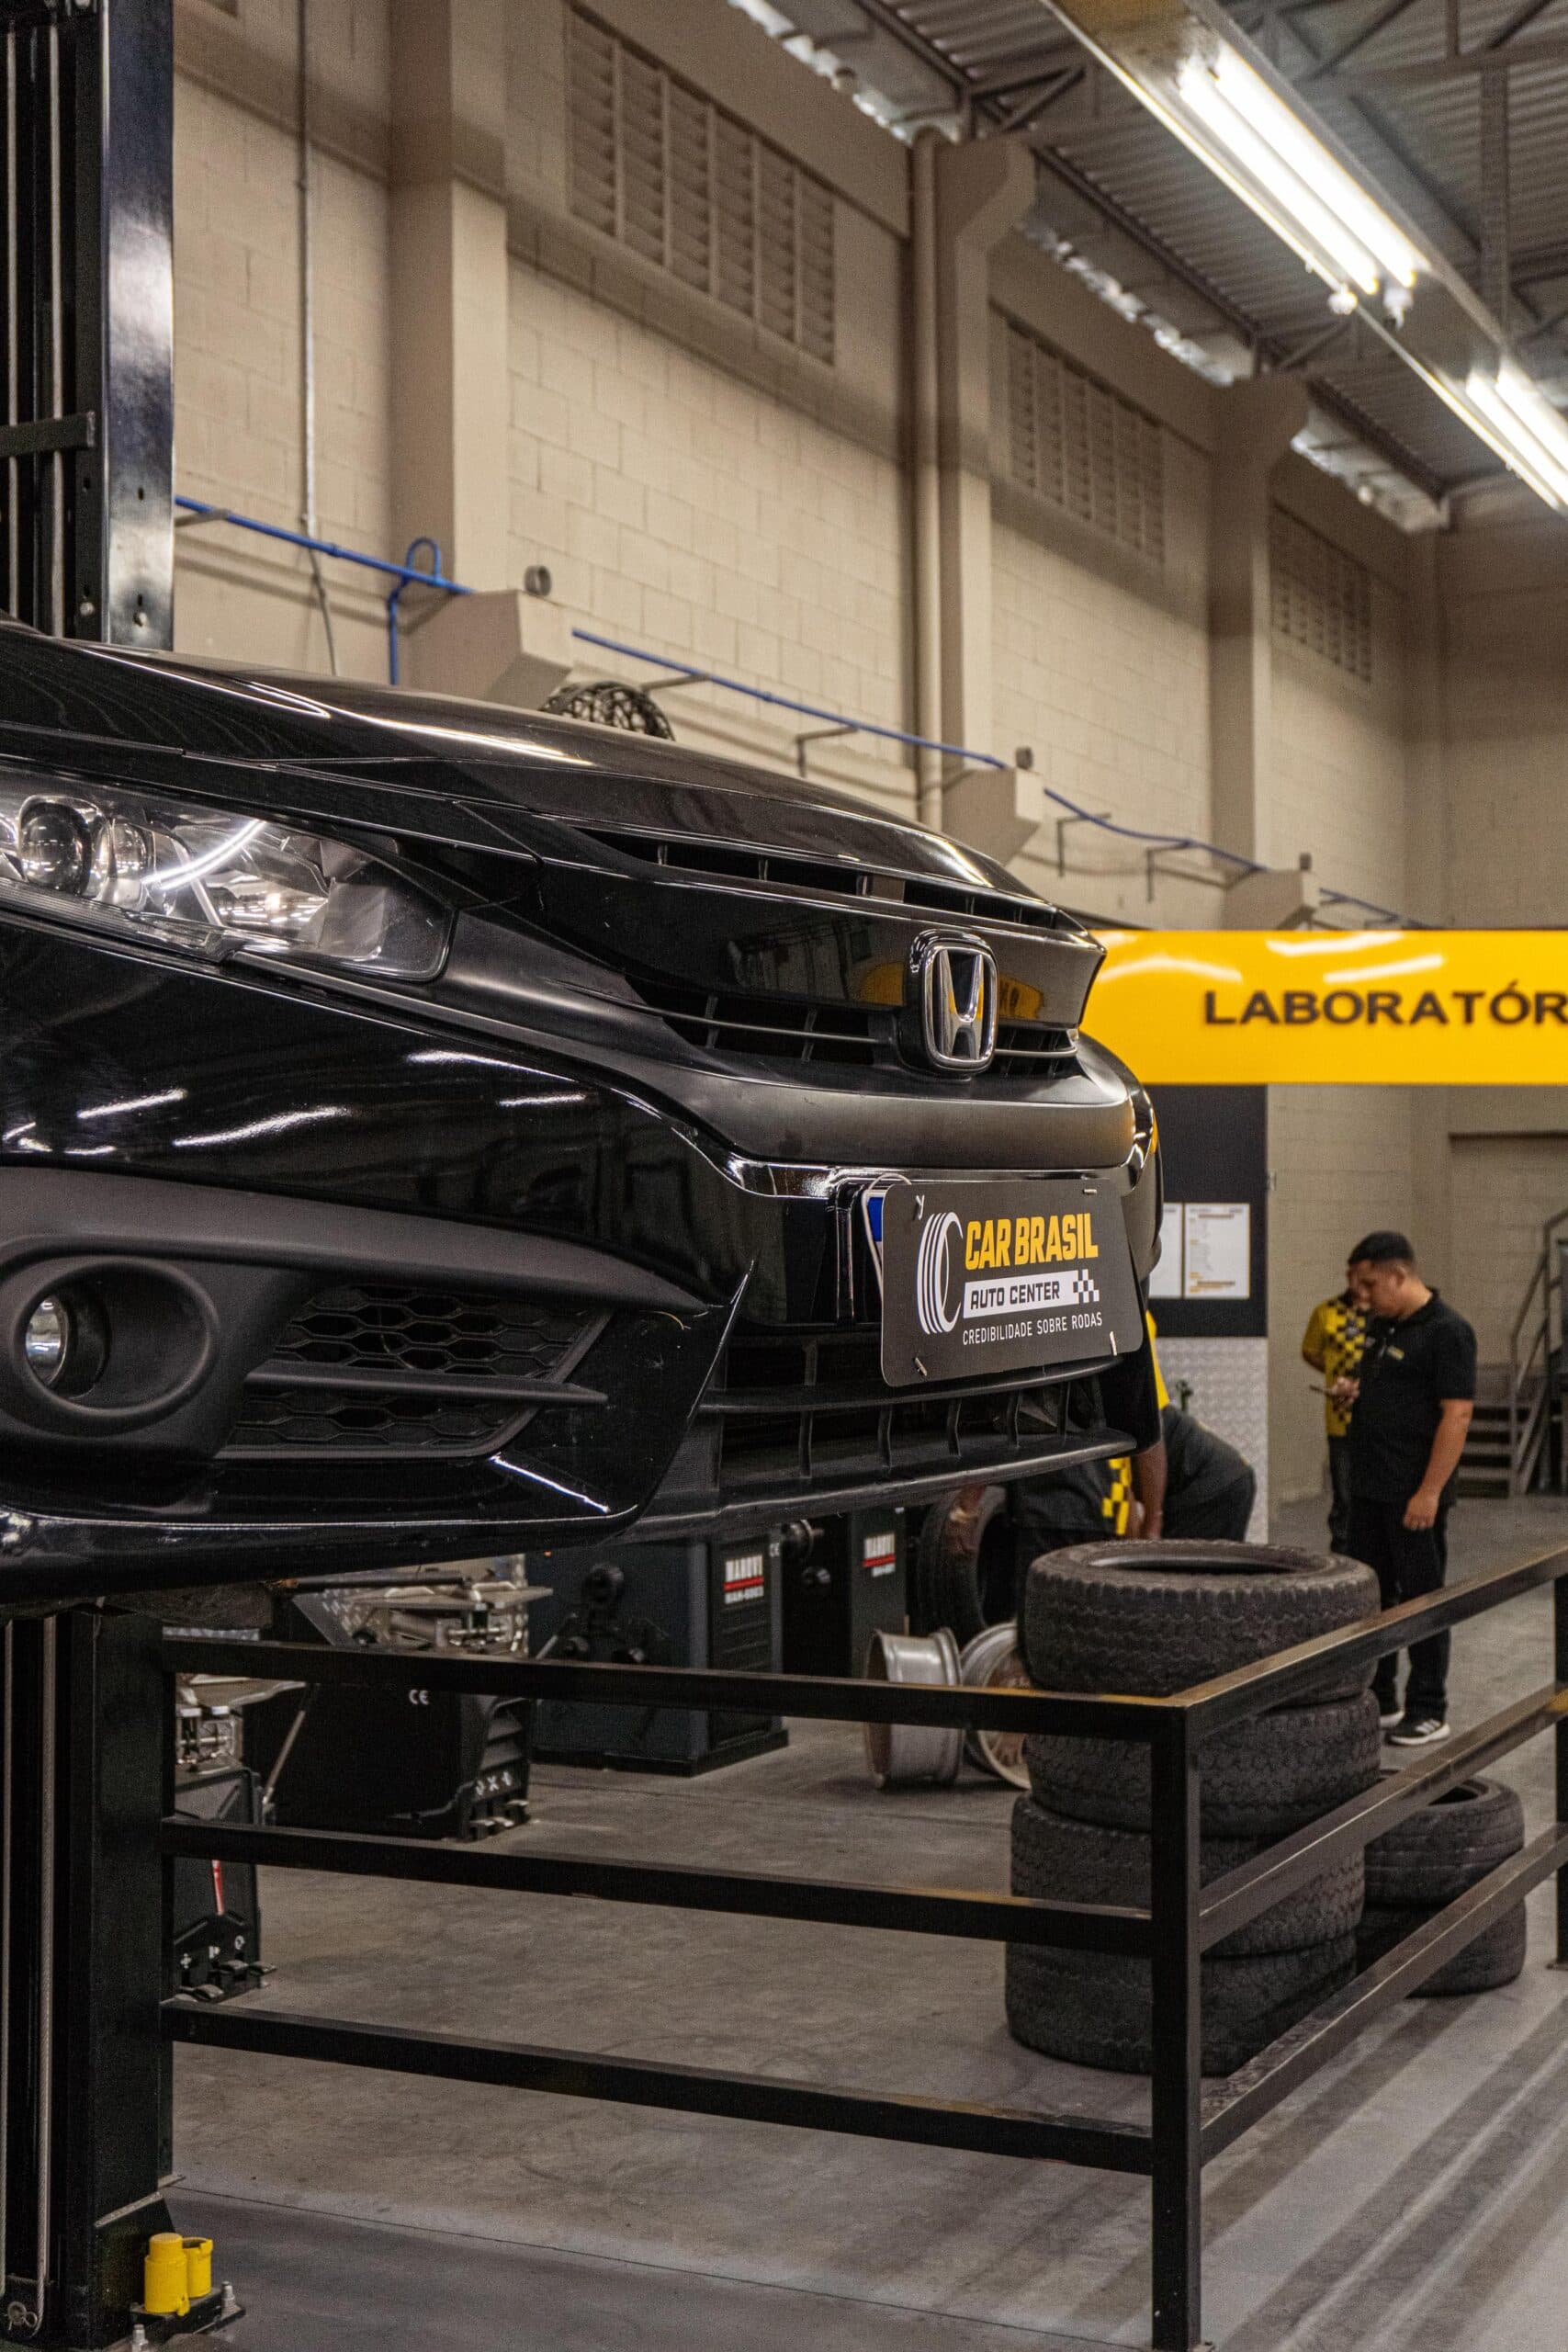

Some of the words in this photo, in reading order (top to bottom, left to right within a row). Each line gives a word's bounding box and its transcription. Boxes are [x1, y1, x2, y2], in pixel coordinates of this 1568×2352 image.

[965, 1219, 1011, 1270] CAR
[1014, 1213, 1099, 1266] BRASIL
[970, 1288, 1005, 1310] AUTO
[1010, 1281, 1060, 1305] CENTER
[963, 1321, 1032, 1346] CREDIBILIDADE
[1036, 1316, 1067, 1336] SOBRE
[1071, 1312, 1102, 1329] RODAS
